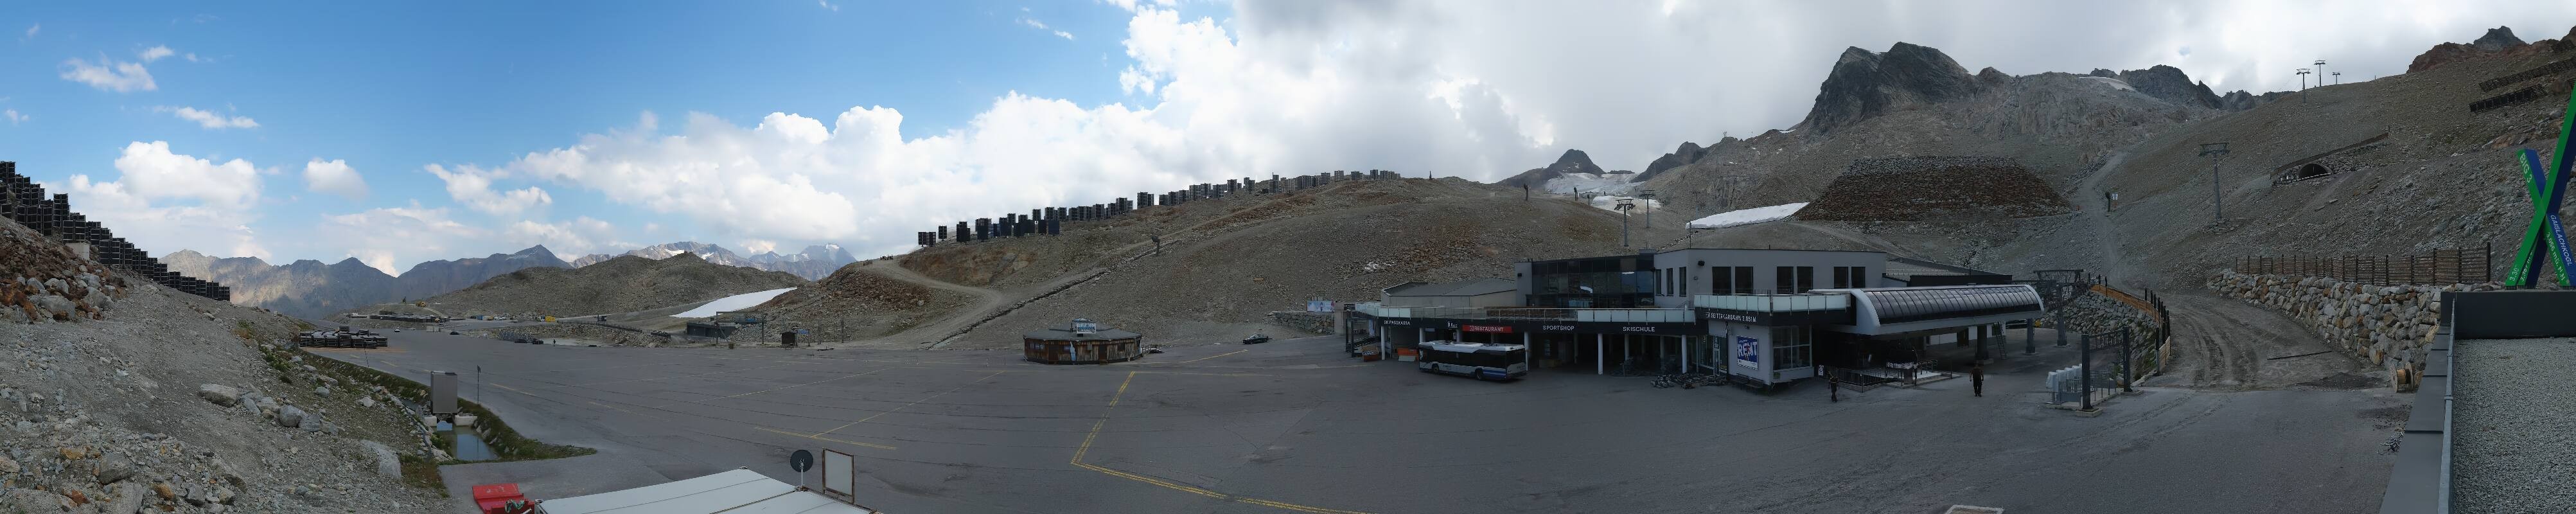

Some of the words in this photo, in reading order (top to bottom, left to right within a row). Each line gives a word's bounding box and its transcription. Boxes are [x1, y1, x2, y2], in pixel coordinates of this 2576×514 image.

[2519, 152, 2529, 173] BIG
[2527, 174, 2532, 183] 3
[2550, 215, 2573, 267] GAISLACHKOGL
[2509, 267, 2519, 281] 3.30
[1738, 342, 1758, 357] RENT
